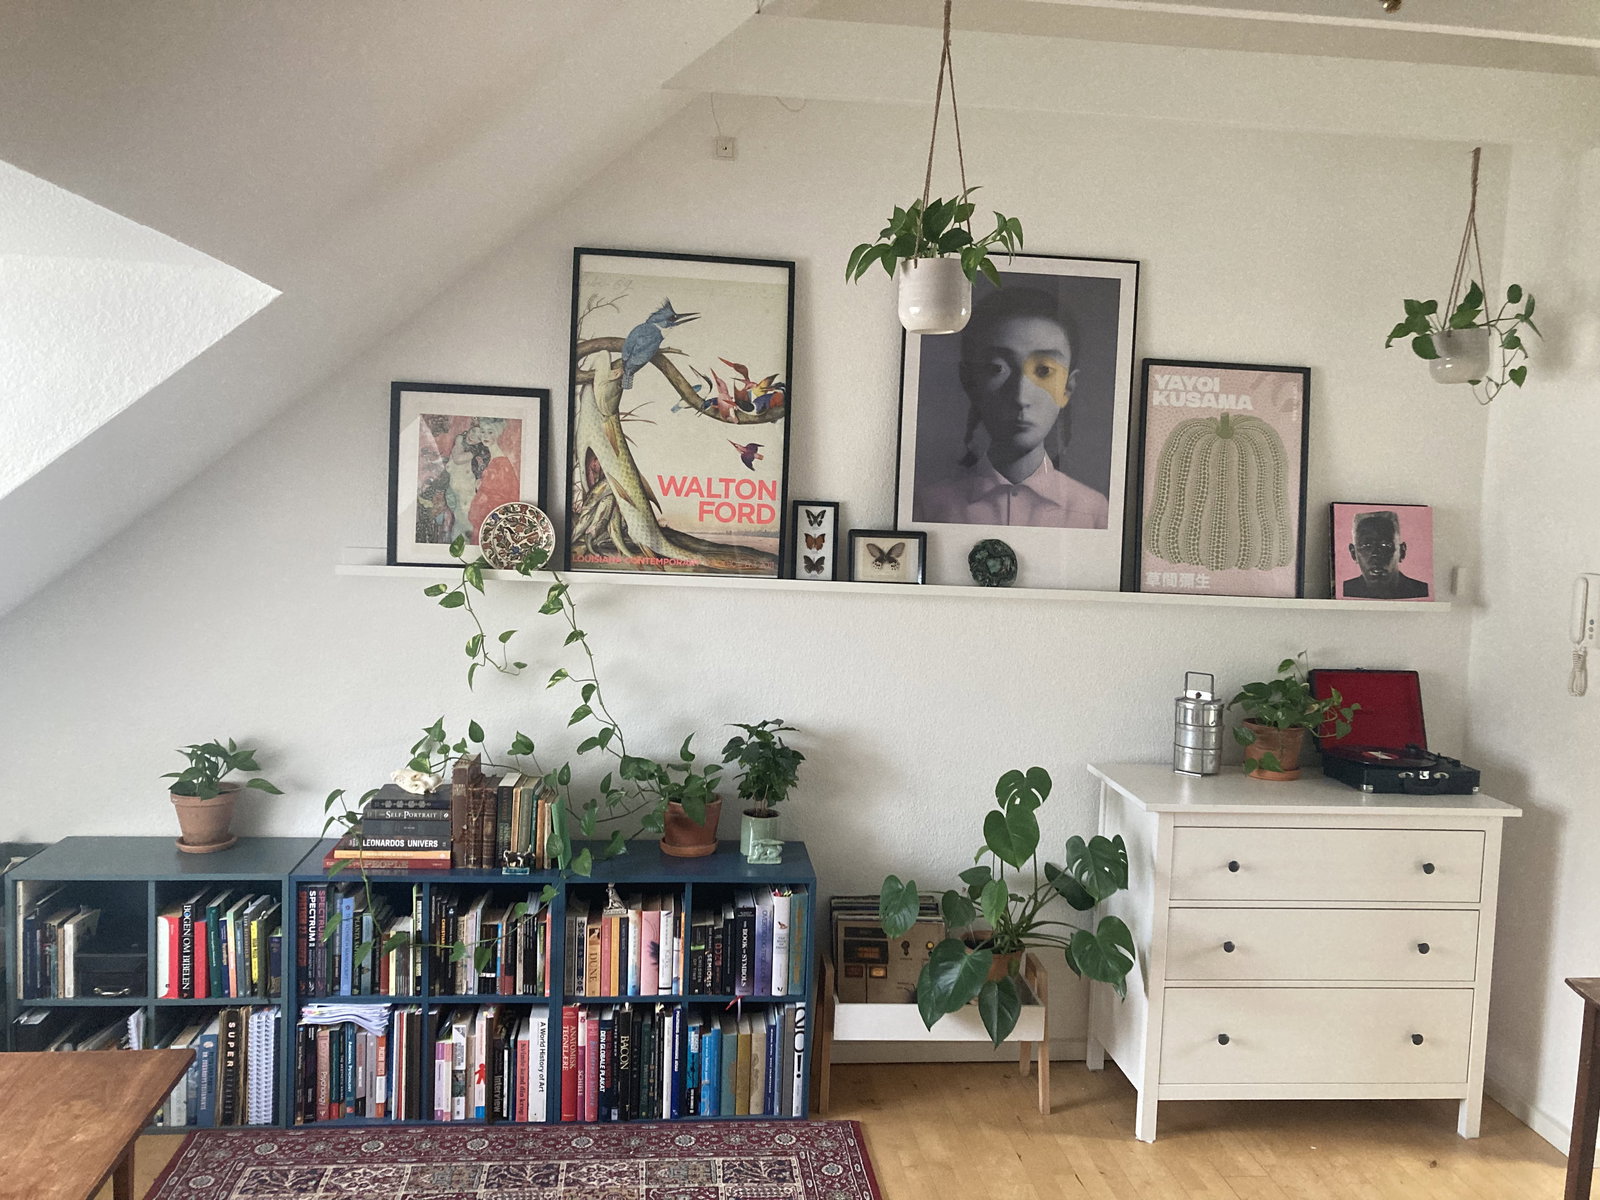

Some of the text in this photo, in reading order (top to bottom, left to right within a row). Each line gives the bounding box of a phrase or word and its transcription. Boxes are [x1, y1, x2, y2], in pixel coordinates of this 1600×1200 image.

[1153, 374, 1220, 393] YAYOI
[1152, 390, 1253, 410] KUSAMA
[657, 475, 777, 500] WALTON
[698, 501, 776, 525] FORD
[362, 839, 438, 848] LEONARDOS UNIVERS
[182, 905, 192, 990] BOGEN OM BIBELEN
[589, 953, 597, 982] DUNE
[227, 1022, 236, 1067] SUPER
[620, 1036, 629, 1070] BACON
[319, 1071, 327, 1105] Psychology
[493, 1075, 502, 1113] Interview
